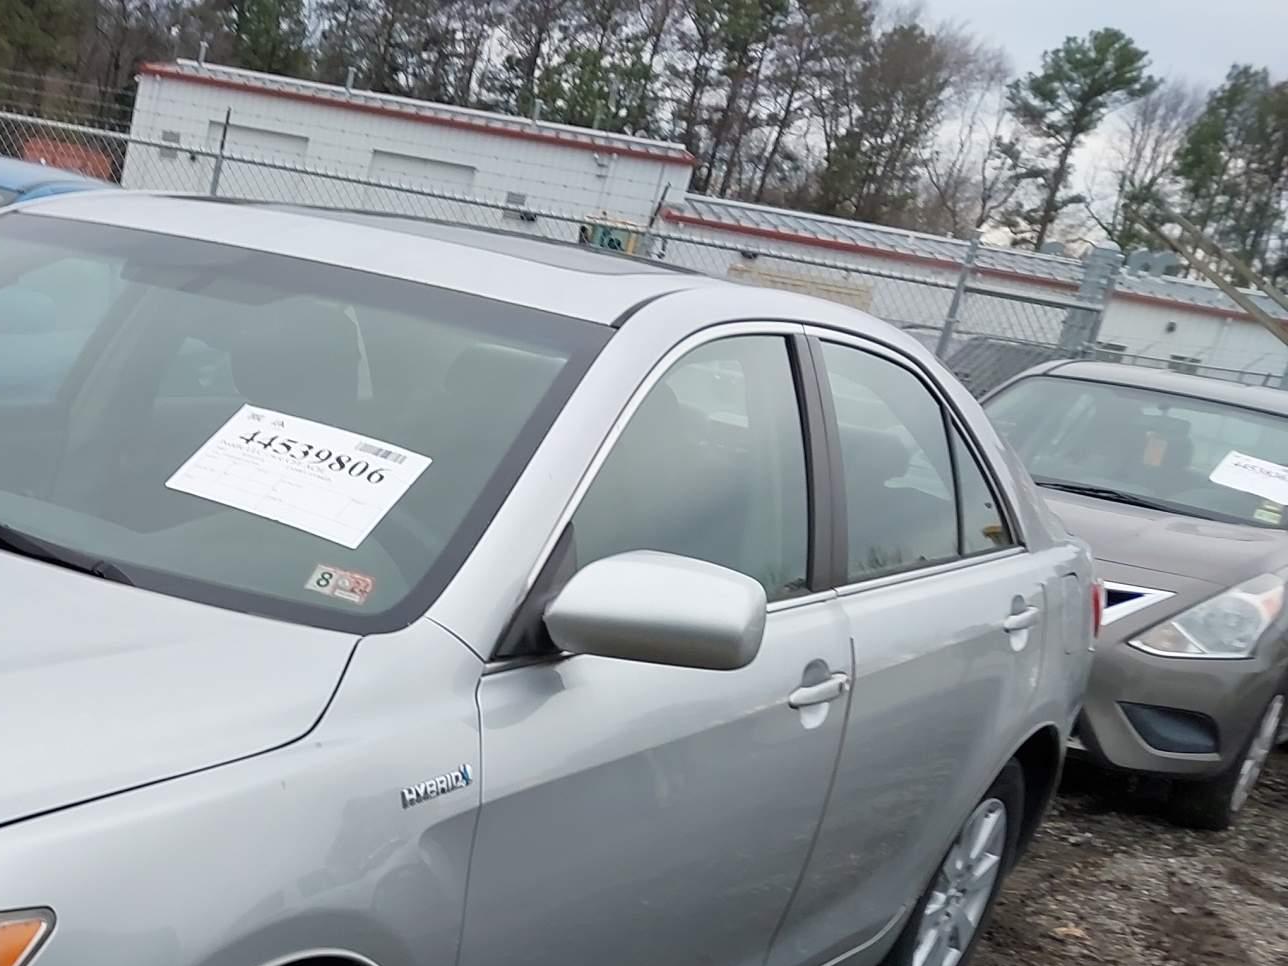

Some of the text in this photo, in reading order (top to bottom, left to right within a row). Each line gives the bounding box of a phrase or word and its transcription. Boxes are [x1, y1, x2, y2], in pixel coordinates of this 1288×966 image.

[239, 430, 386, 485] 44539806
[316, 571, 333, 588] 8
[400, 770, 468, 810] HYBRID
